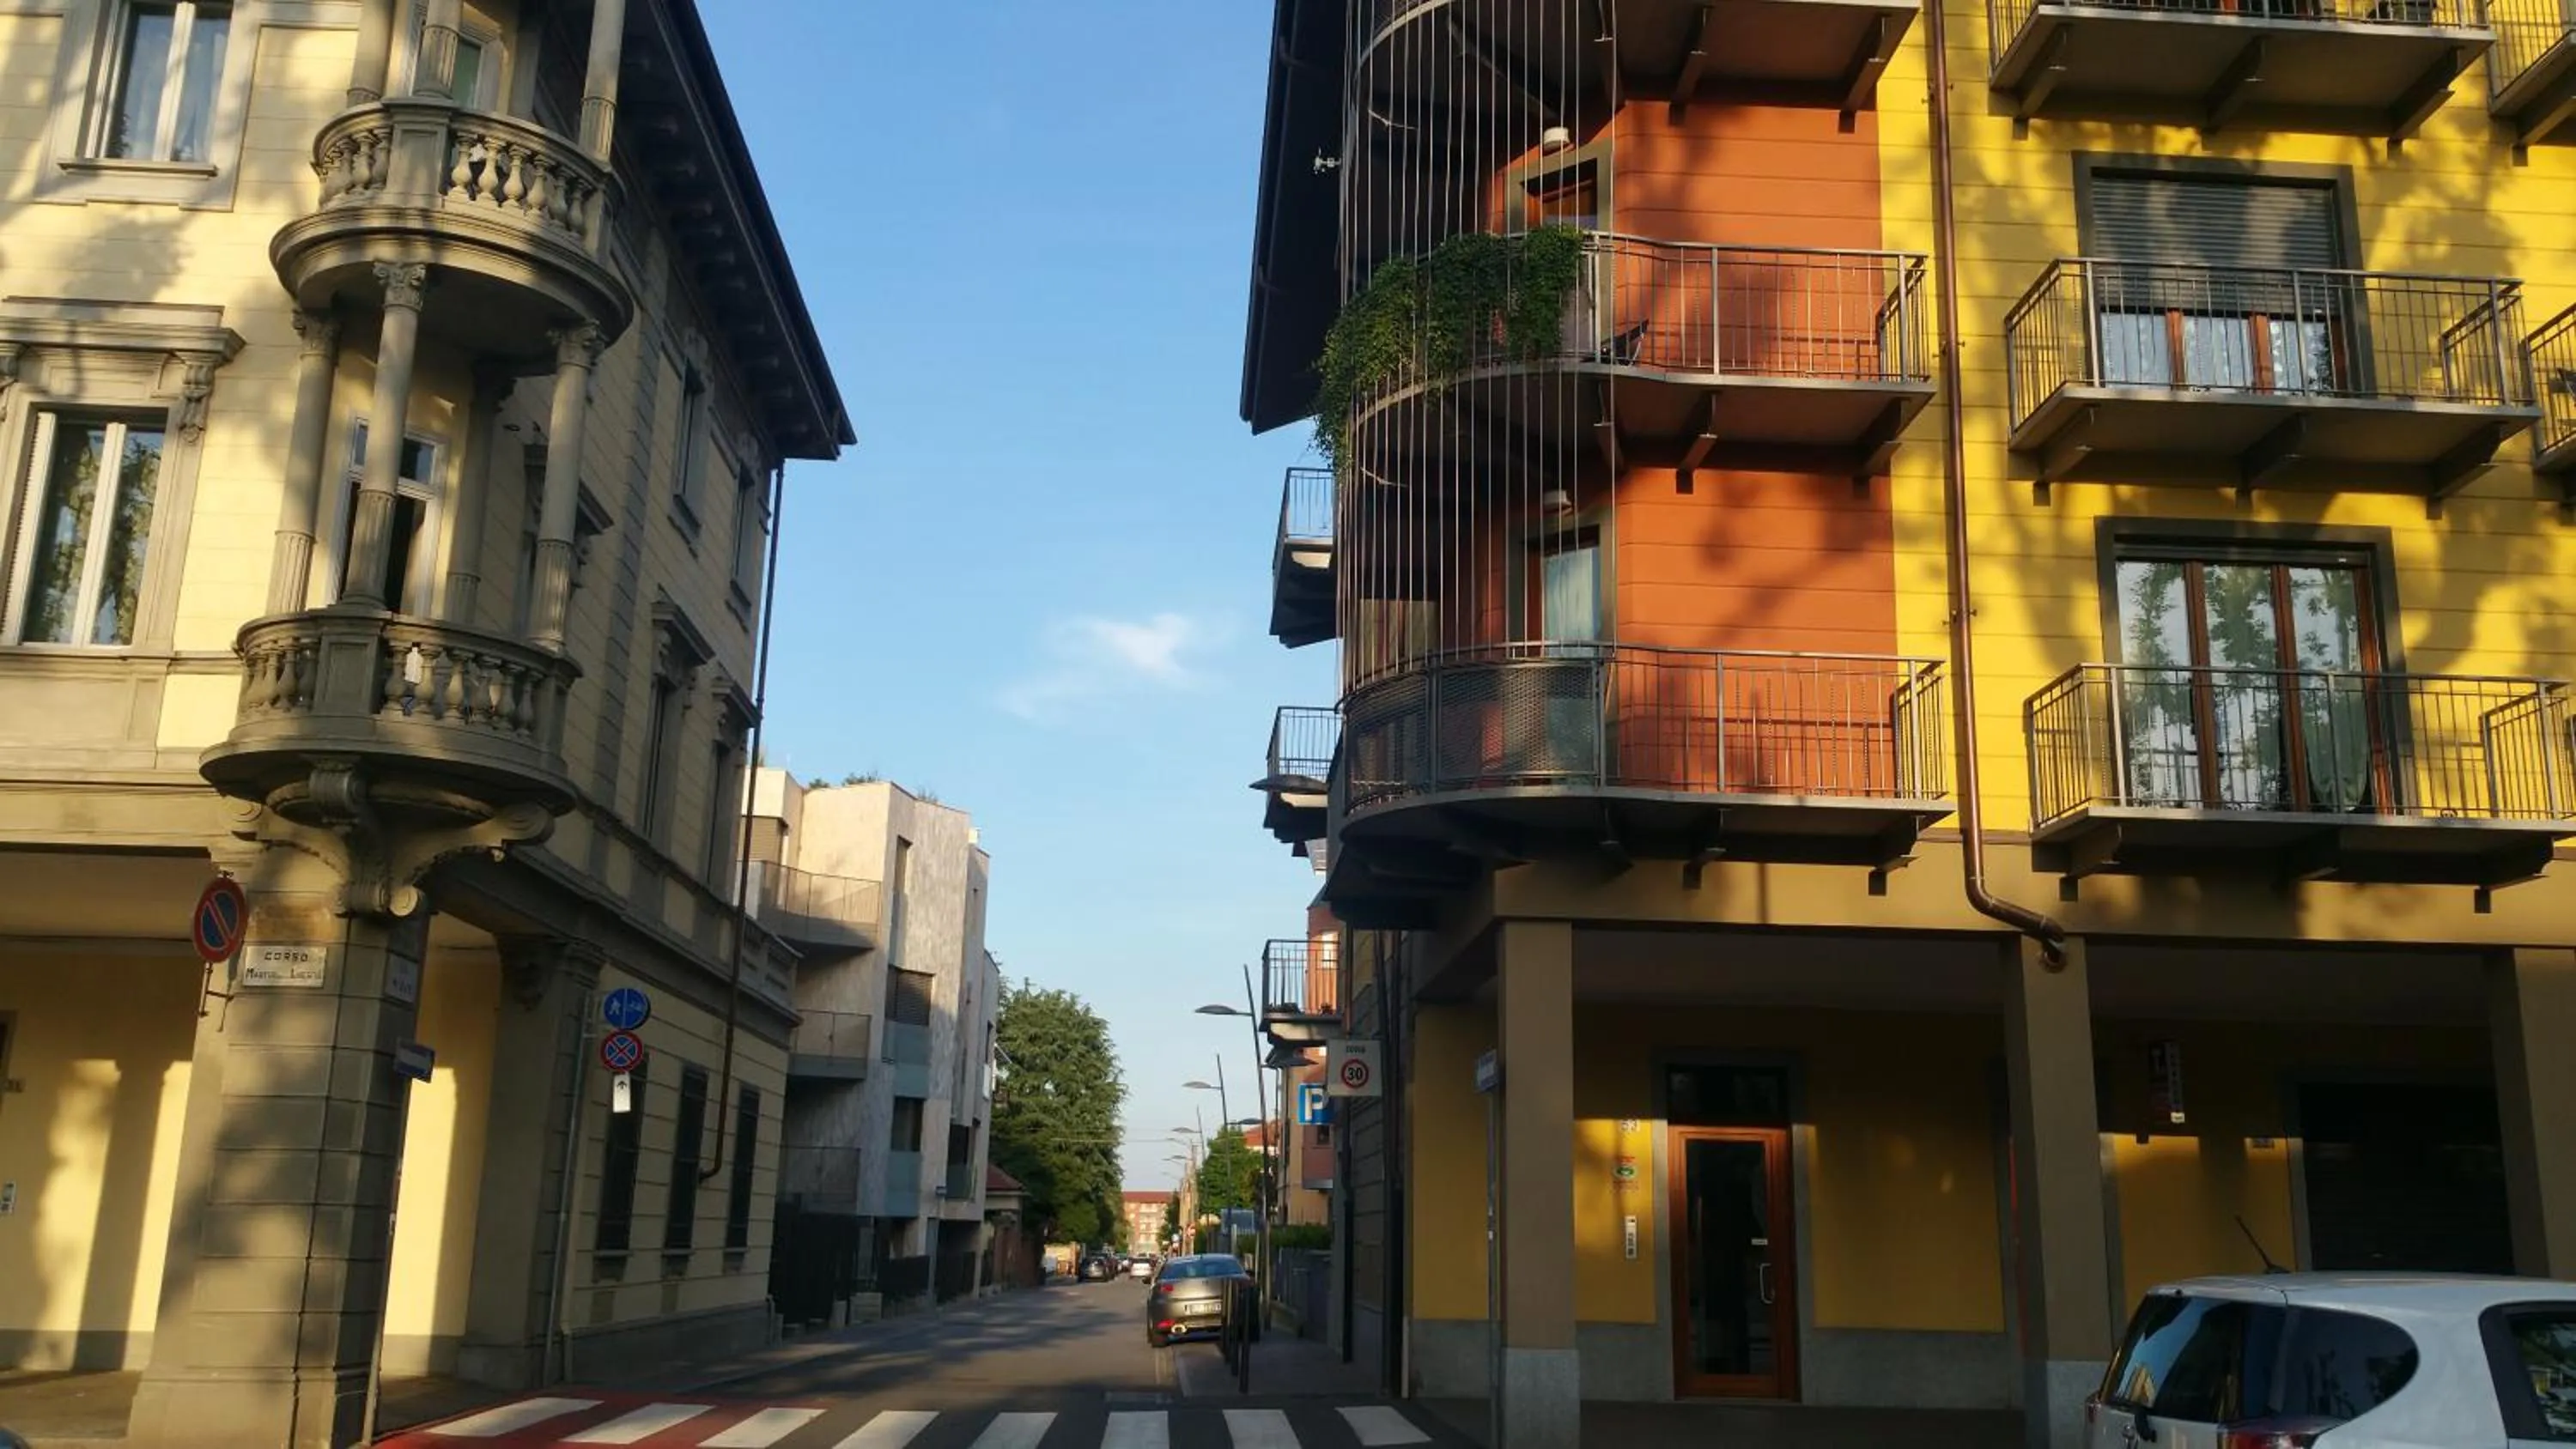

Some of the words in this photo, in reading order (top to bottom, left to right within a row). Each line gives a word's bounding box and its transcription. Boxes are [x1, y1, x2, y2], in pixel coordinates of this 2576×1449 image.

[264, 952, 308, 962] CORSO
[1347, 1067, 1364, 1081] 30
[1304, 1087, 1330, 1121] P
